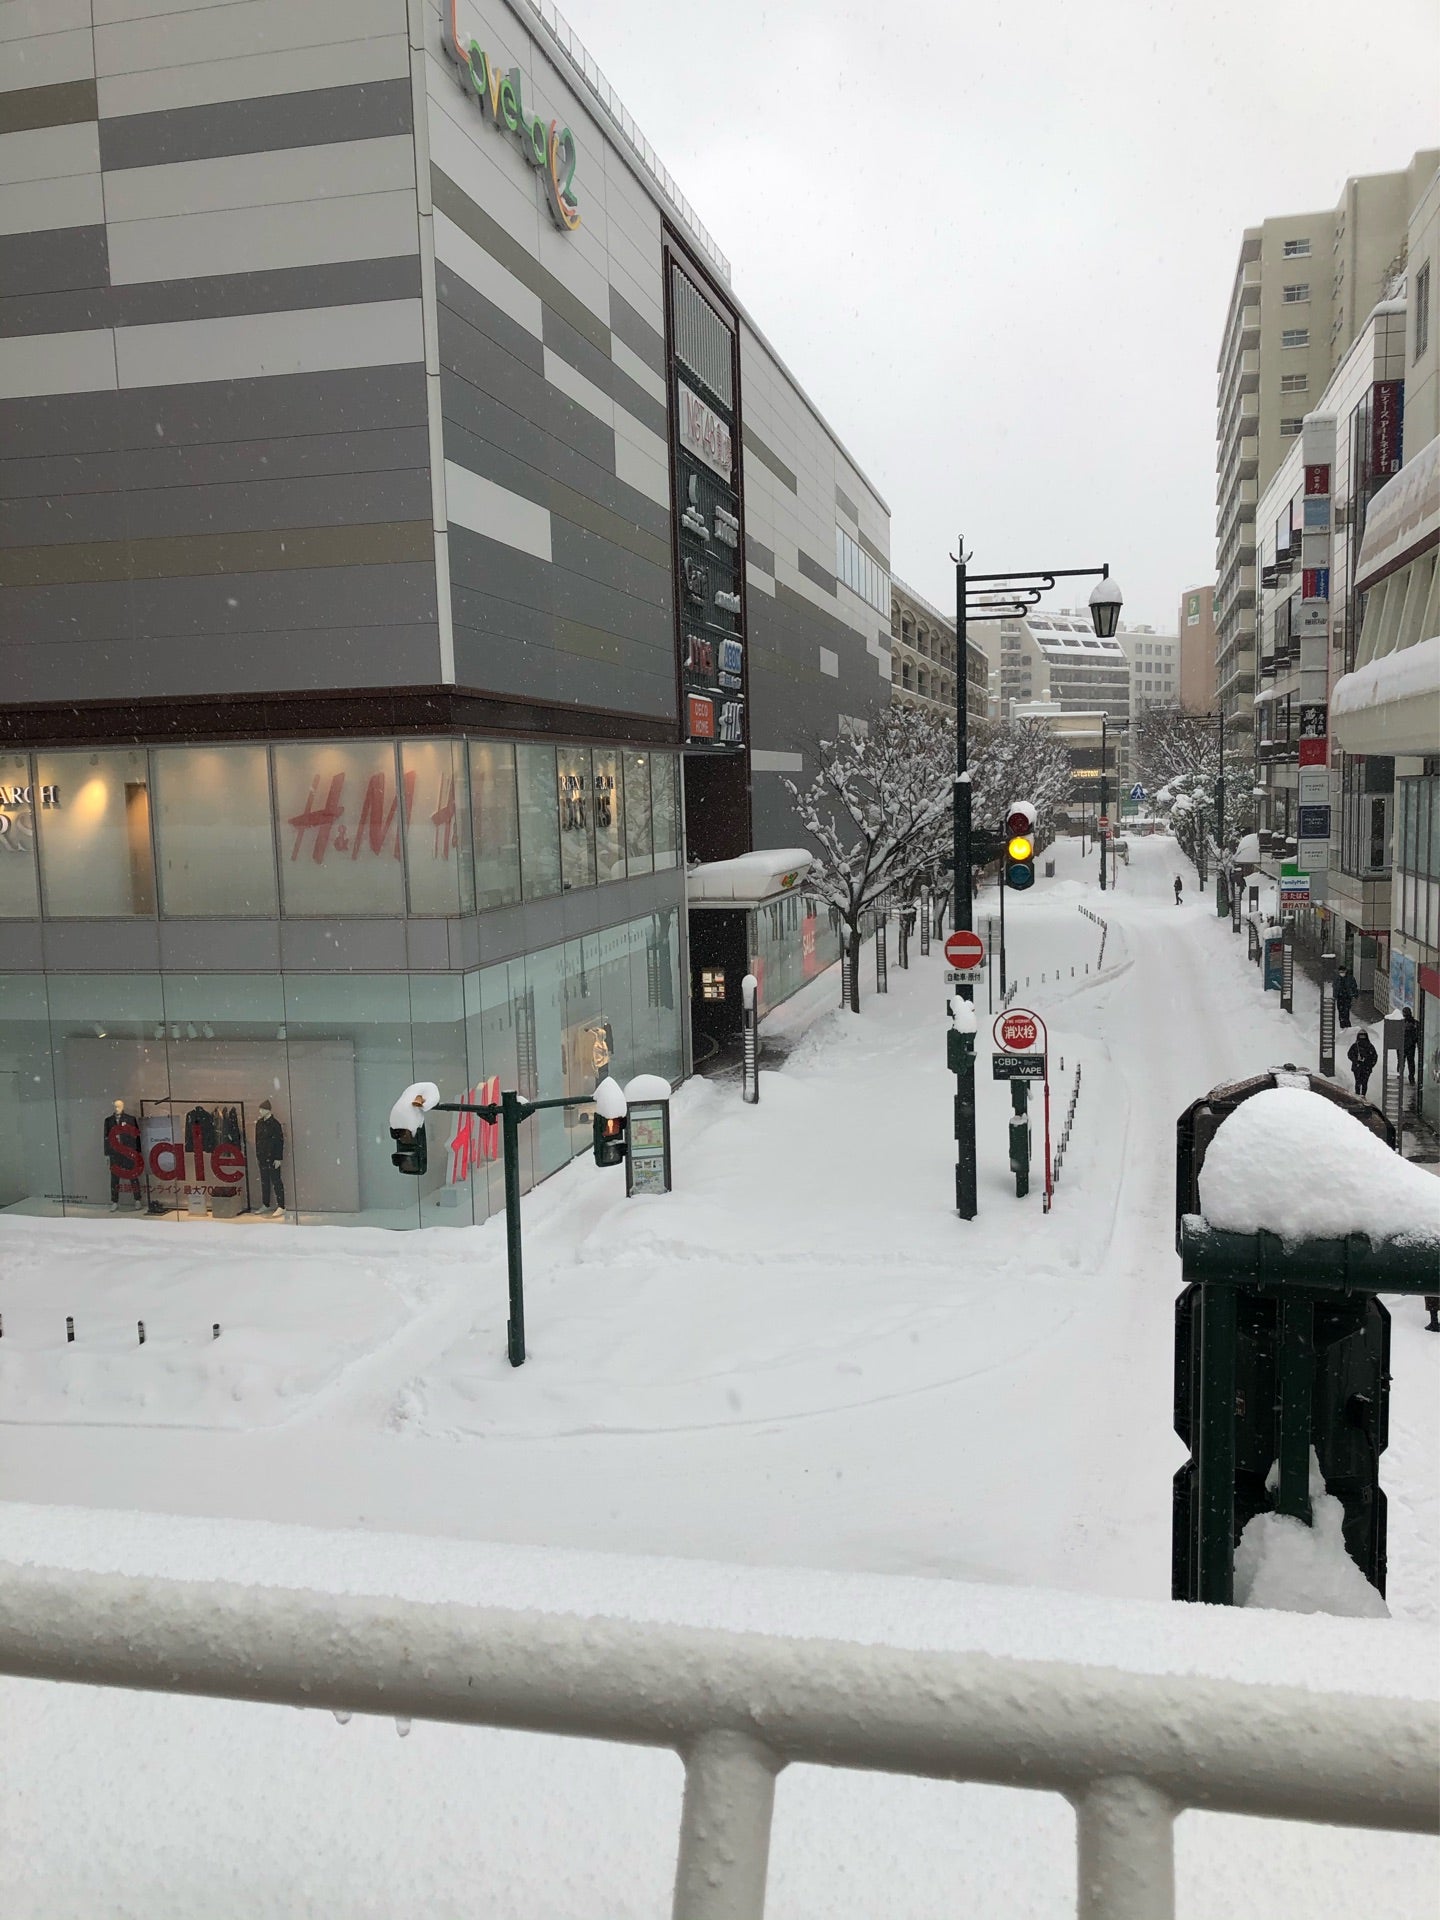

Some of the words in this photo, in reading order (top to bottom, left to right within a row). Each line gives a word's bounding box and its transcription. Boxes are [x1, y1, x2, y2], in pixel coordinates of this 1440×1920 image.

[288, 770, 416, 865] H&M
[1004, 1024, 1035, 1040] 消火栓
[1018, 1066, 1043, 1074] VAPE
[108, 1123, 247, 1183] Sale
